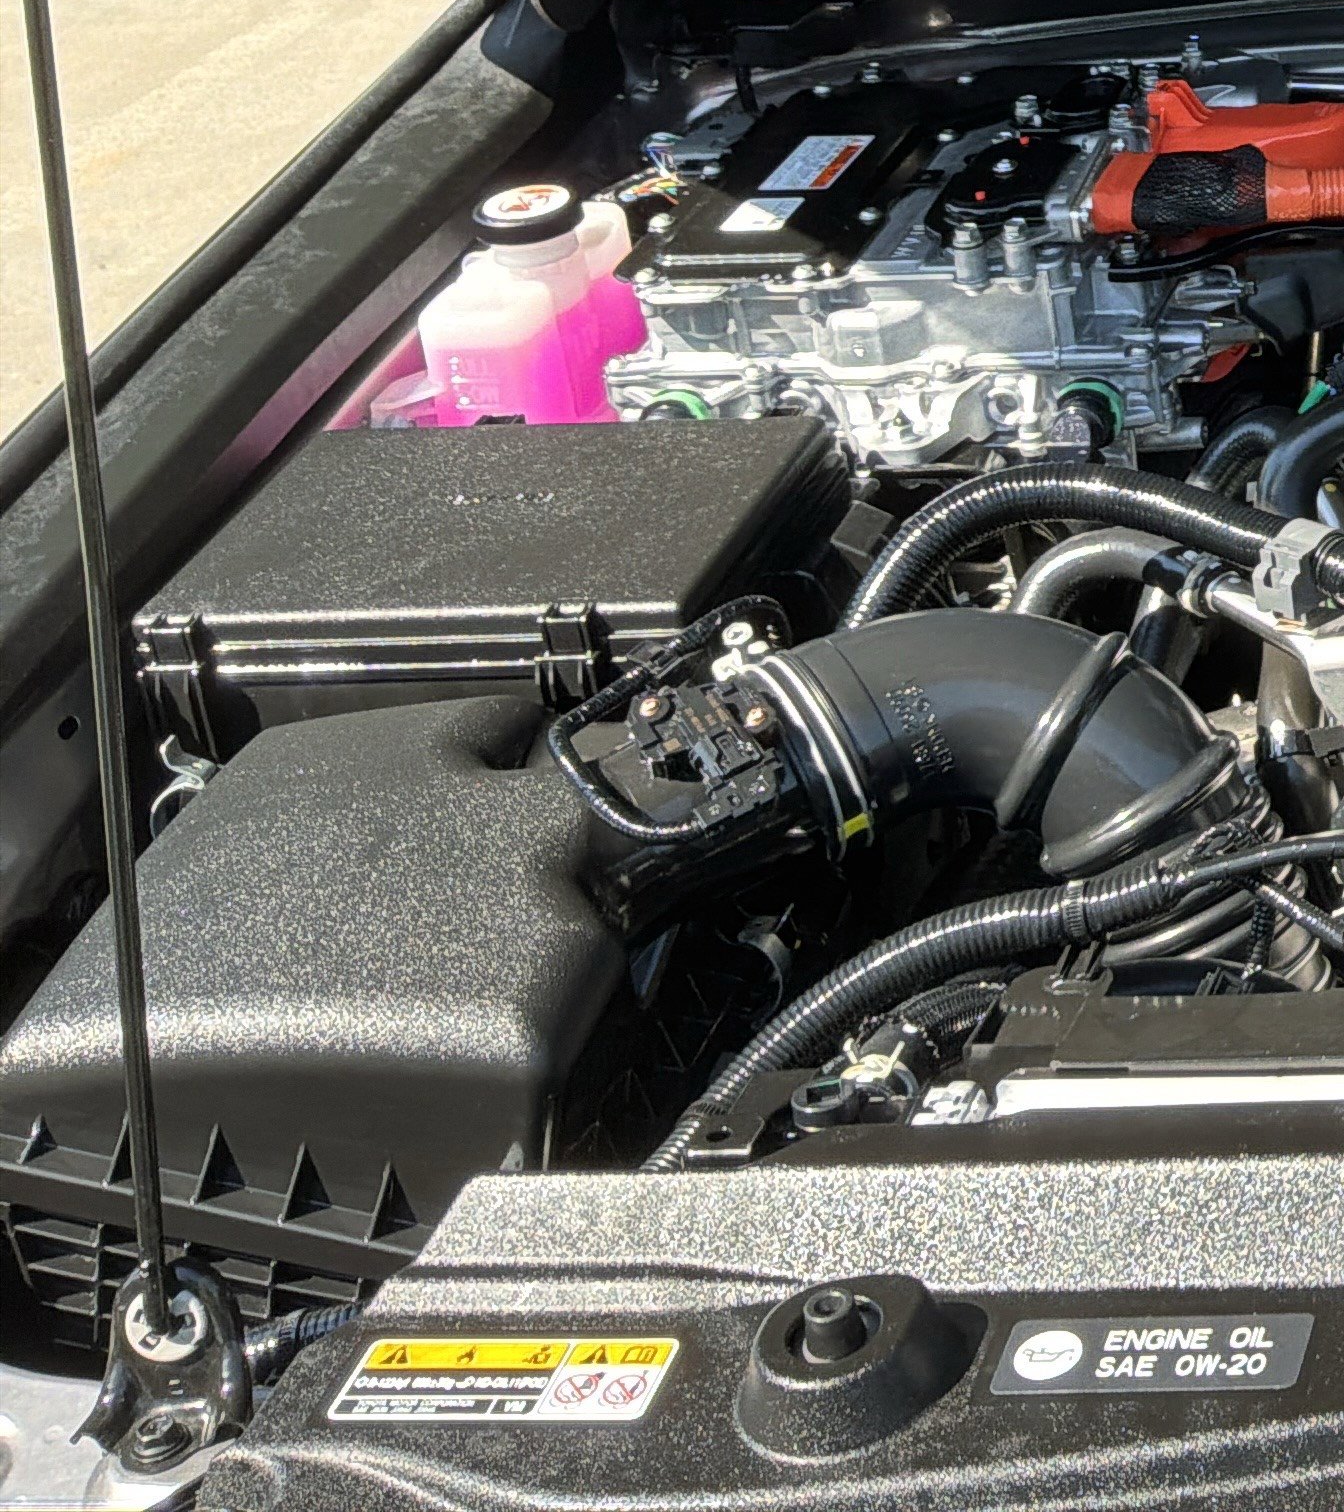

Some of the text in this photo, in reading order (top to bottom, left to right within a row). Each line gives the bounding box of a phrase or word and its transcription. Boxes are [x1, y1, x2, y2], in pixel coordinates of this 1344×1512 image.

[1103, 1326, 1274, 1352] ENGINE OIL
[1094, 1353, 1268, 1379] SAE 0W-20
